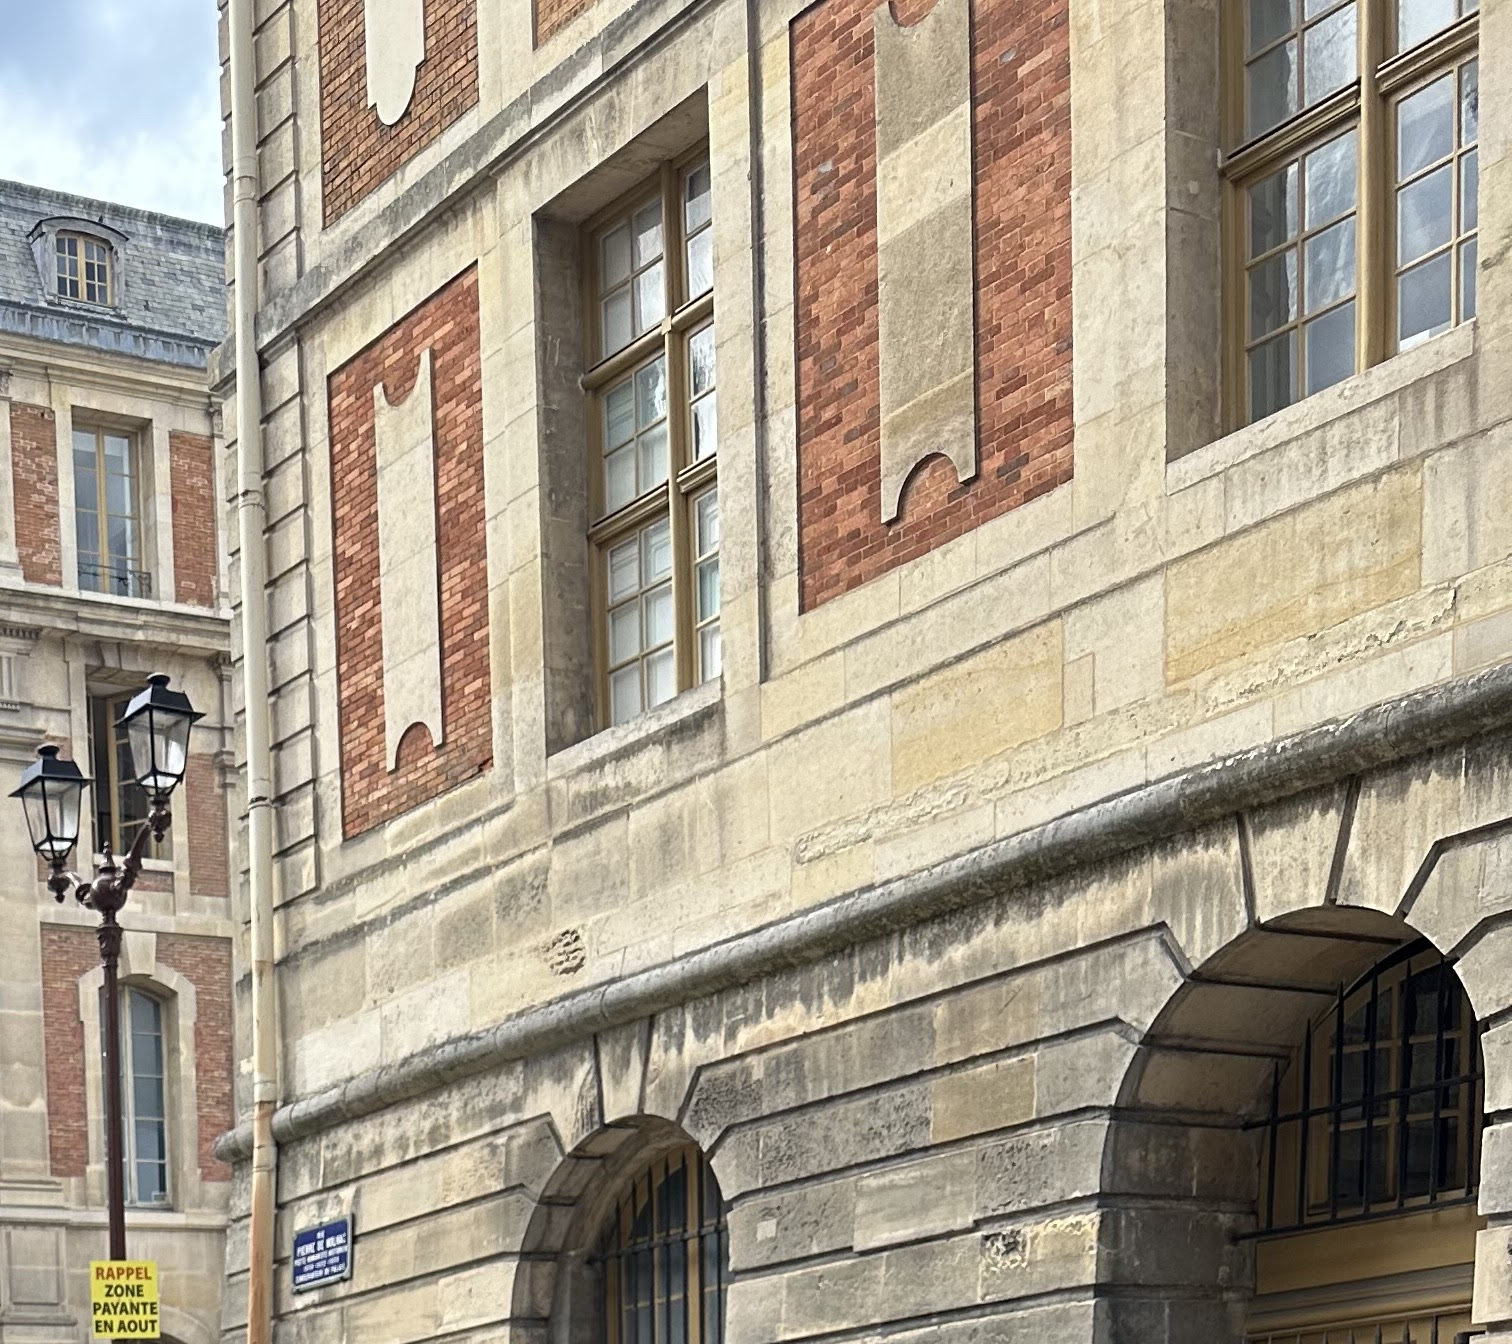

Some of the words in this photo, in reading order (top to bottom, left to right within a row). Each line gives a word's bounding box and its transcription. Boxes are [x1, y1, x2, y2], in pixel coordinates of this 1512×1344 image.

[95, 1267, 152, 1280] RAPPEL
[105, 1284, 144, 1297] ZONE
[93, 1302, 158, 1315] PAYANTE
[95, 1320, 113, 1333] EN
[117, 1320, 157, 1333] AOUT
